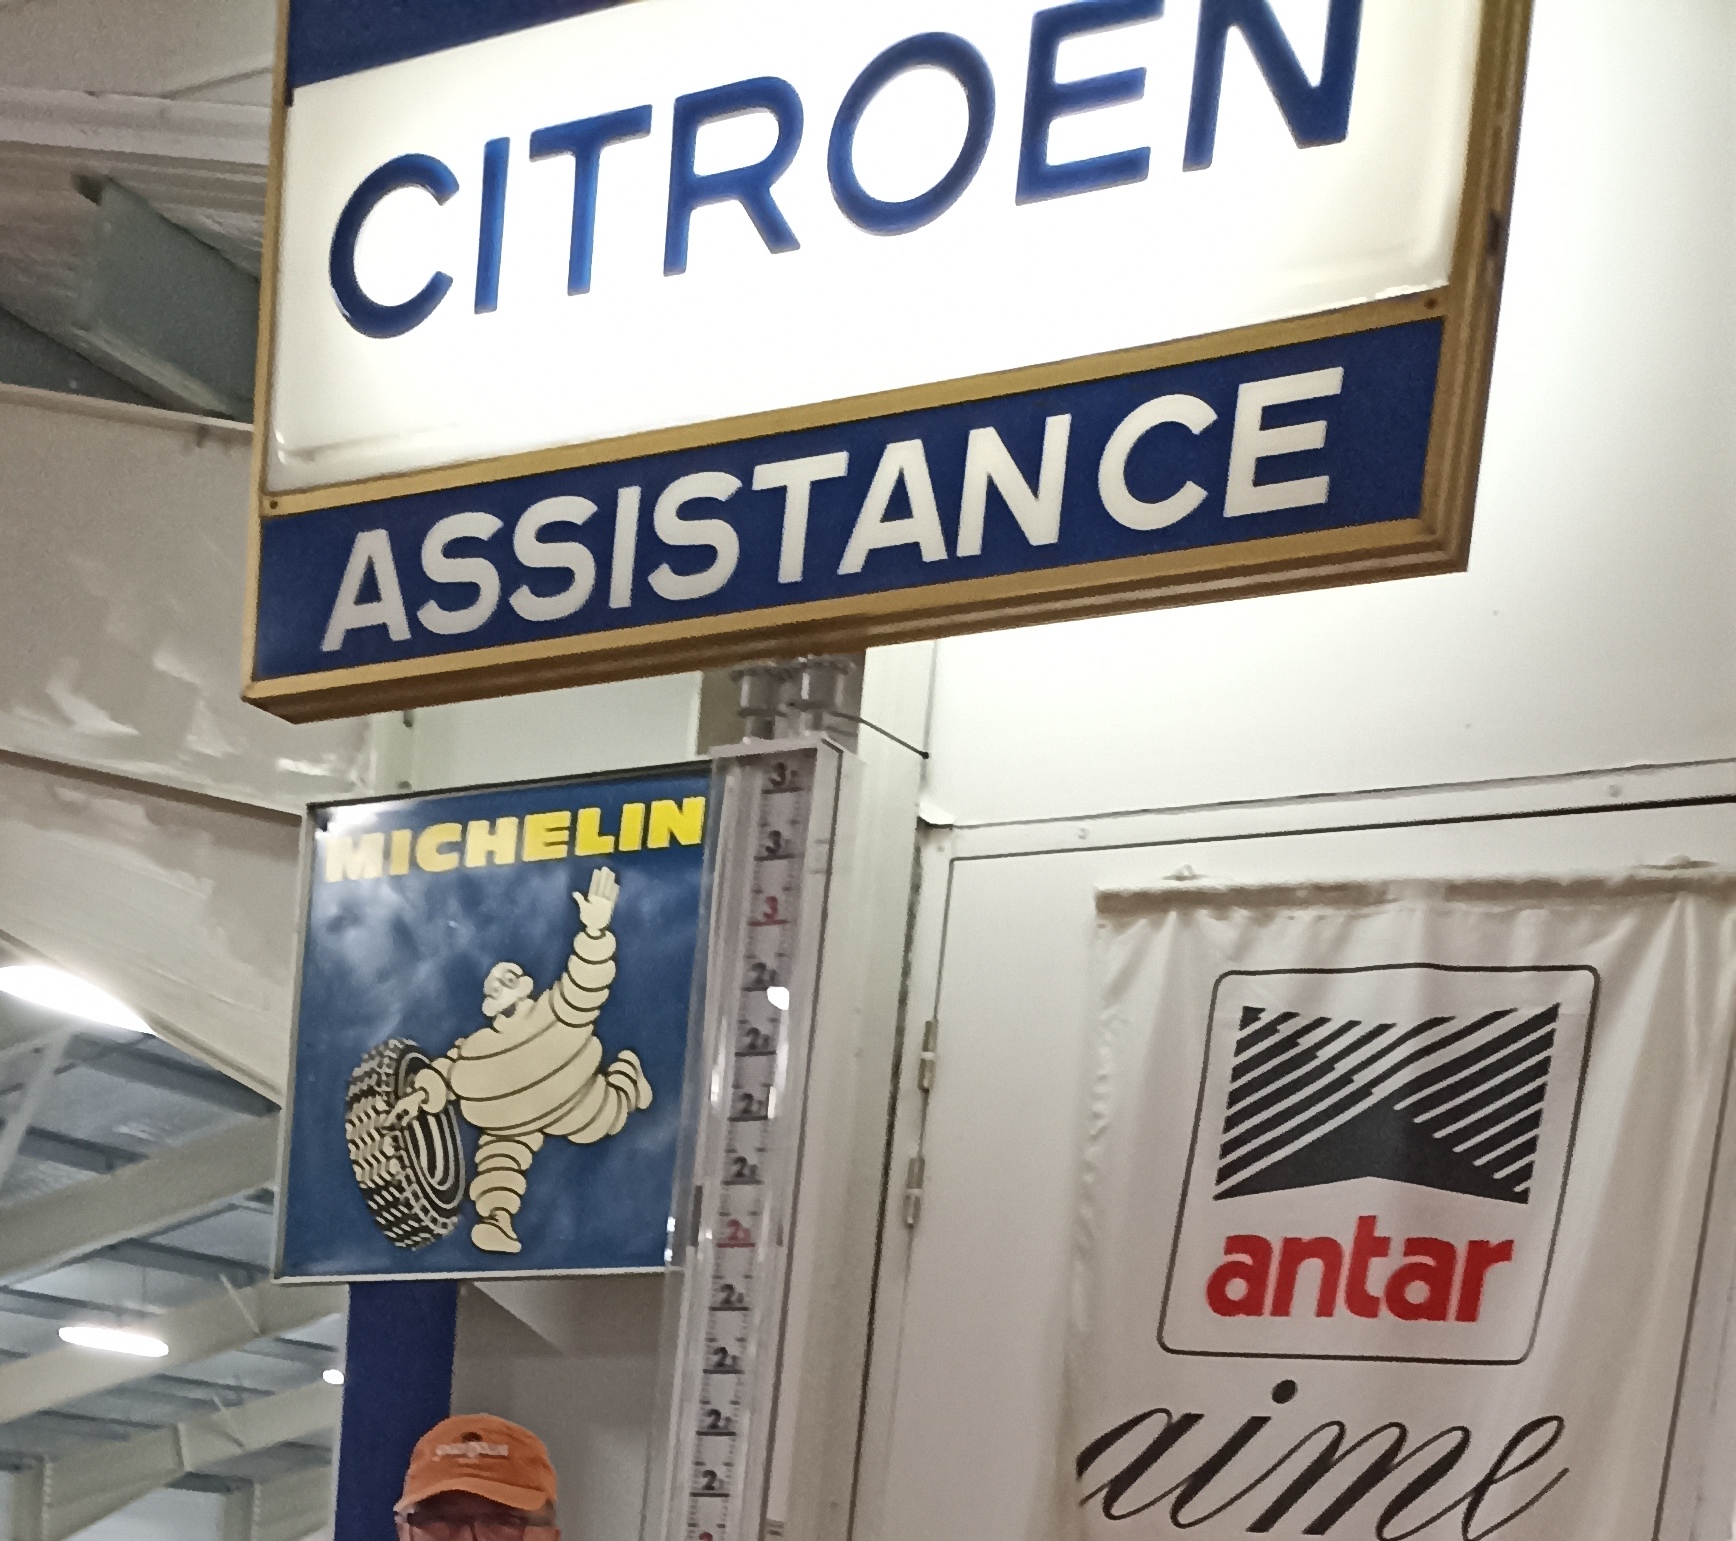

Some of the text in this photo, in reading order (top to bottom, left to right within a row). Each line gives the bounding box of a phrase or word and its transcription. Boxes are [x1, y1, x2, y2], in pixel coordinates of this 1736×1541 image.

[328, 0, 1364, 339] CITROEN
[320, 366, 1345, 653] ASSISTANCE
[324, 796, 705, 882] MICHELIN
[1206, 1215, 1514, 1322] antar
